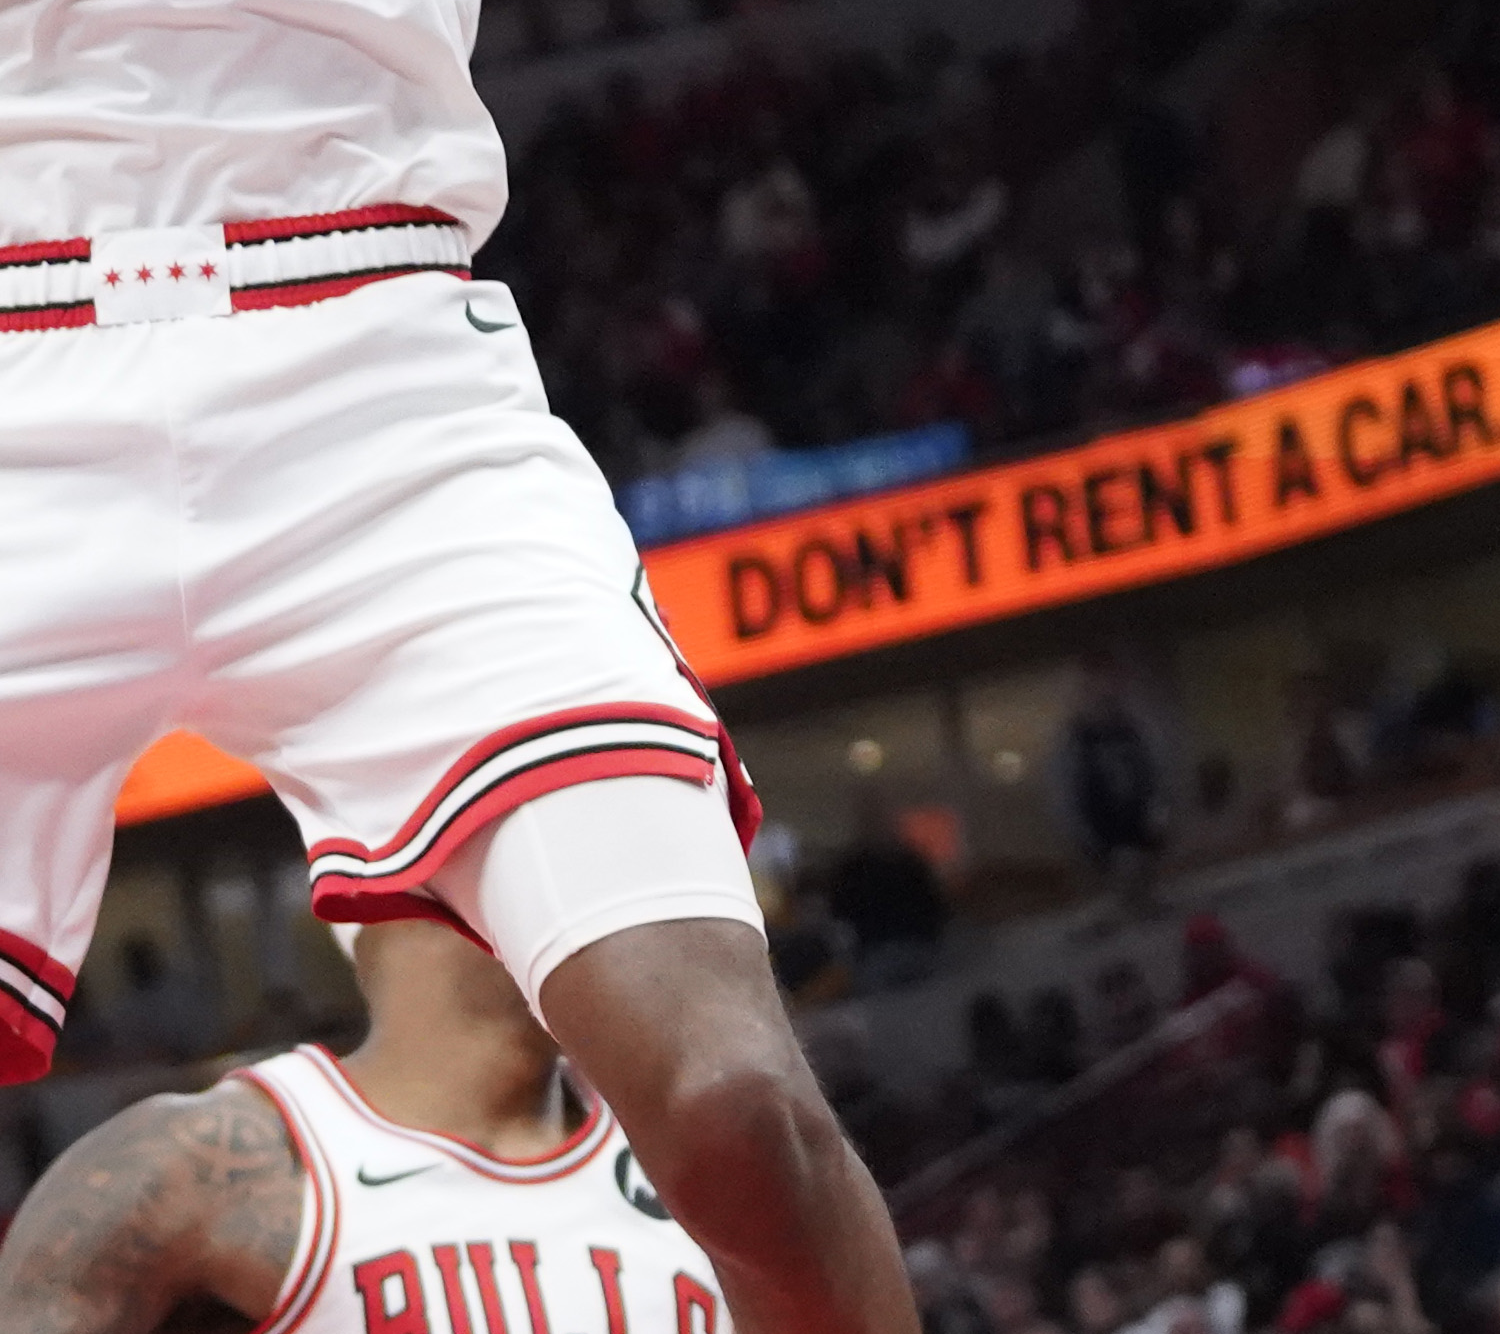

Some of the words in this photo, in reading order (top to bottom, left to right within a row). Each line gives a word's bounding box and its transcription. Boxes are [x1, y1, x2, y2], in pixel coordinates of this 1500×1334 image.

[727, 499, 993, 644] DON'T
[1021, 440, 1246, 574] RENT
[1272, 410, 1323, 511] A
